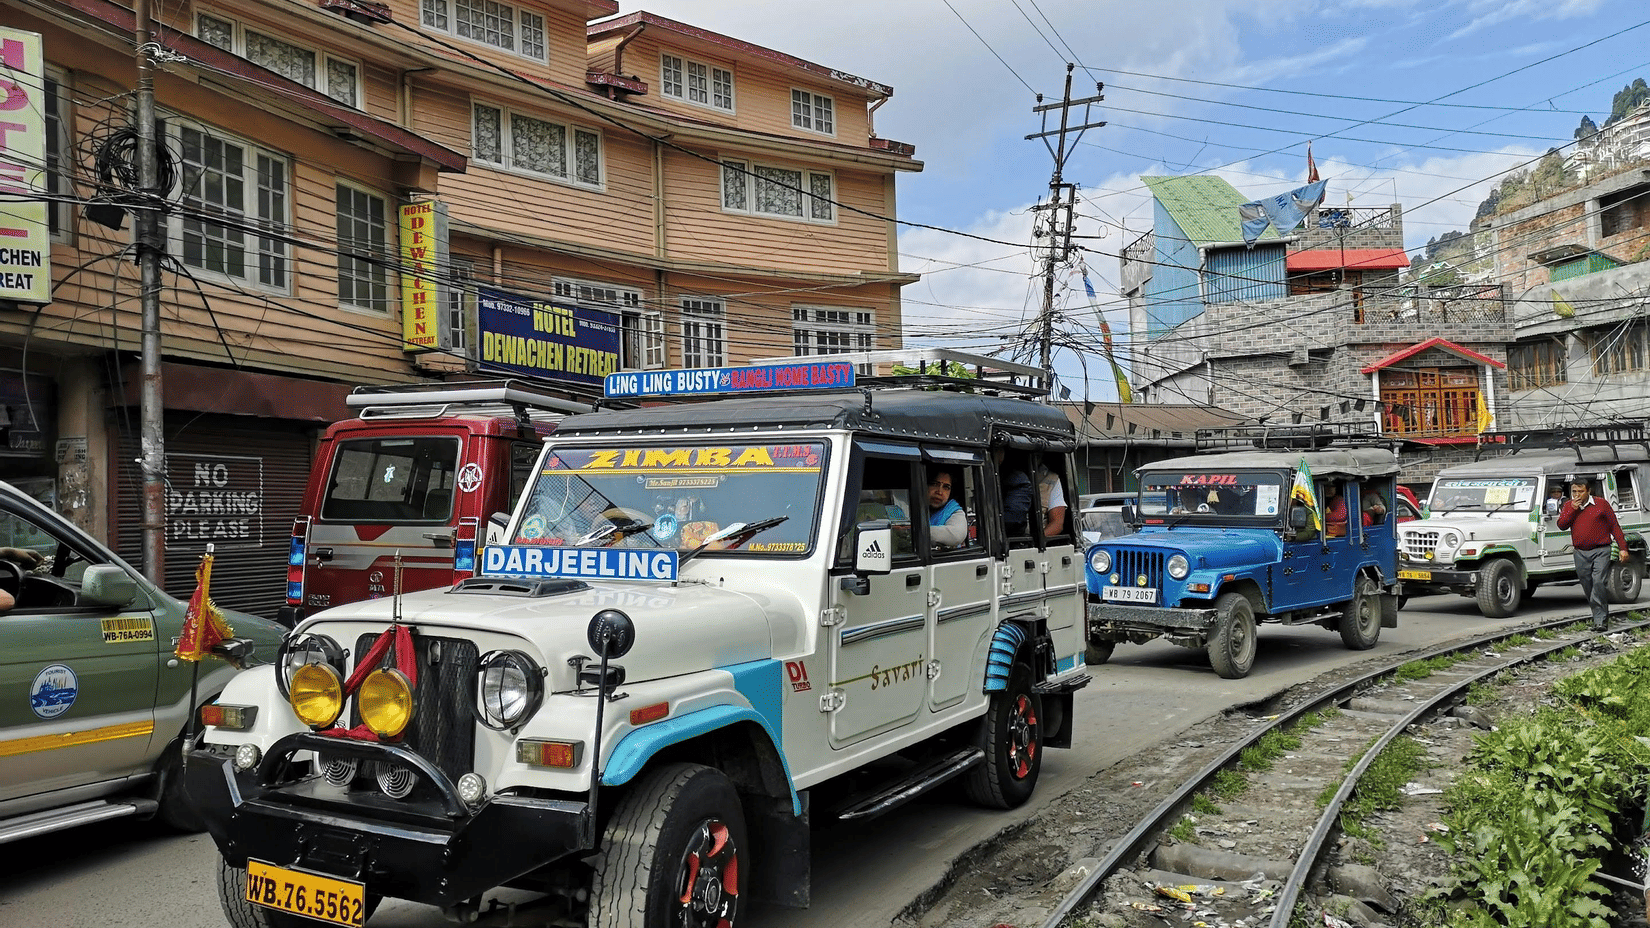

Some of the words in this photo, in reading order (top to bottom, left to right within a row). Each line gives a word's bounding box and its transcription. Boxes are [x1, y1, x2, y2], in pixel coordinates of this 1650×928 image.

[404, 204, 431, 215] HOTEL
[410, 216, 426, 335] DEWACHEN
[533, 302, 576, 337] HOTEL
[407, 335, 435, 346] RETREAT
[483, 330, 563, 371] DEWACHEN
[566, 344, 618, 377] RETREAT
[609, 374, 638, 394] LING
[643, 372, 672, 393] LING
[677, 369, 721, 391] BUSTY
[811, 363, 851, 385] BASTY
[581, 447, 774, 468] ZIMBA
[194, 463, 228, 488] NO
[1180, 474, 1238, 485] KAPIL
[170, 490, 258, 515] PARKING
[173, 519, 249, 540] PLEASE
[487, 548, 672, 579] DARJEELING
[862, 551, 885, 559] adidas
[1109, 589, 1119, 598] WB
[1122, 590, 1132, 599] 79
[1135, 591, 1154, 600] 2067
[104, 630, 152, 641] WB-76A-0994
[785, 660, 808, 683] DI
[791, 682, 811, 690] TURBO
[248, 873, 362, 925] WB.76.5562
